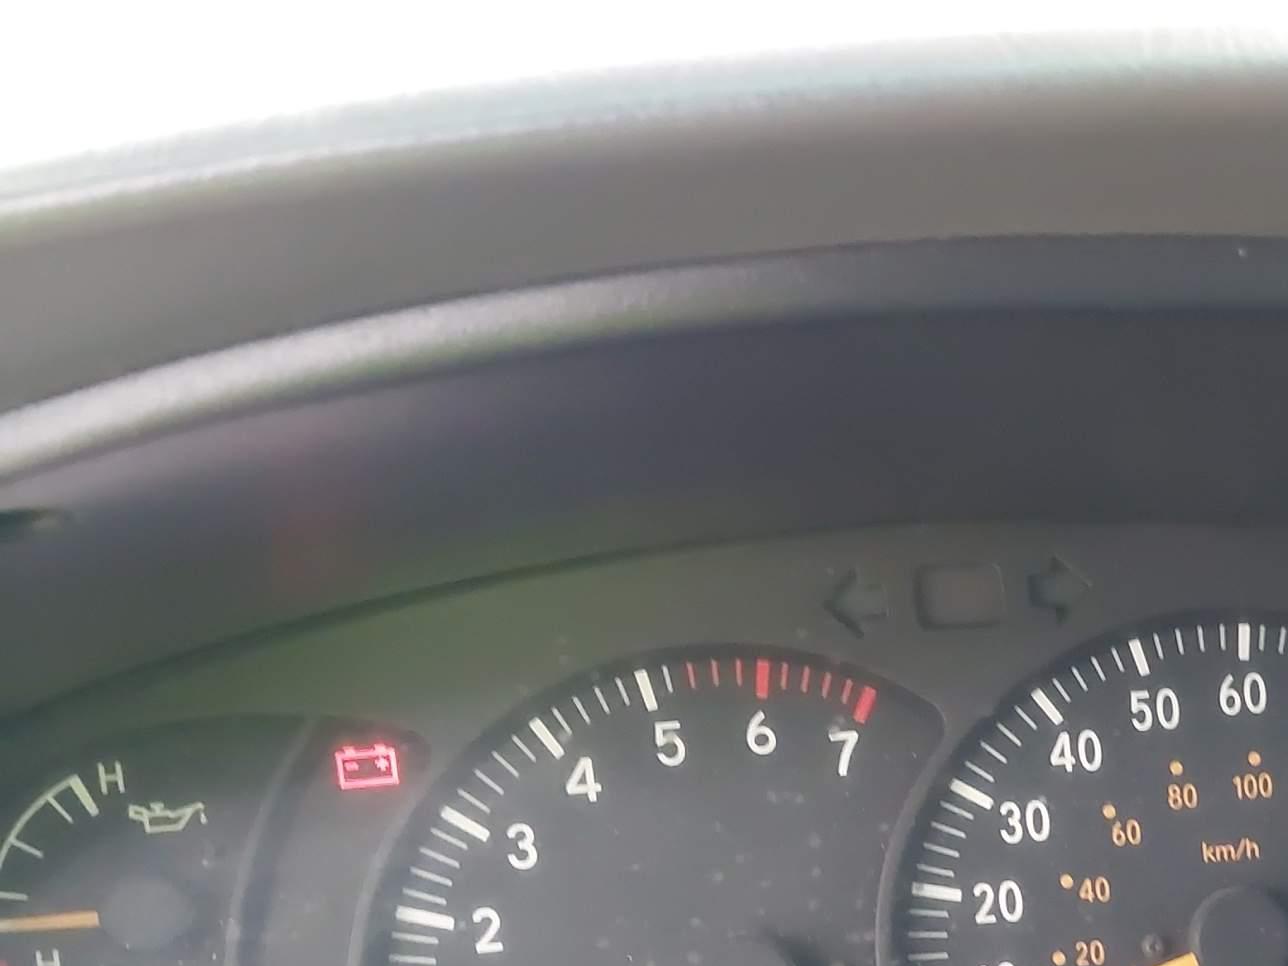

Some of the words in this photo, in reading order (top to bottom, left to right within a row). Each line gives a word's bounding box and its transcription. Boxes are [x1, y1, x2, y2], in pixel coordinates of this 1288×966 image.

[1130, 687, 1180, 732] 50
[1219, 672, 1267, 716] 60
[654, 720, 686, 767] 5
[746, 710, 777, 755] 6
[828, 730, 859, 777] 7
[1050, 729, 1102, 773] 40
[97, 761, 126, 795] H
[565, 756, 602, 803] 4
[1167, 783, 1198, 810] 80
[1232, 772, 1273, 800] 100
[999, 800, 1051, 845] 30
[1111, 819, 1142, 847] 60
[506, 823, 538, 870] 3
[1201, 836, 1261, 865] km/h
[973, 880, 1024, 924] 20
[1078, 876, 1111, 903] 40
[472, 907, 504, 955] 2
